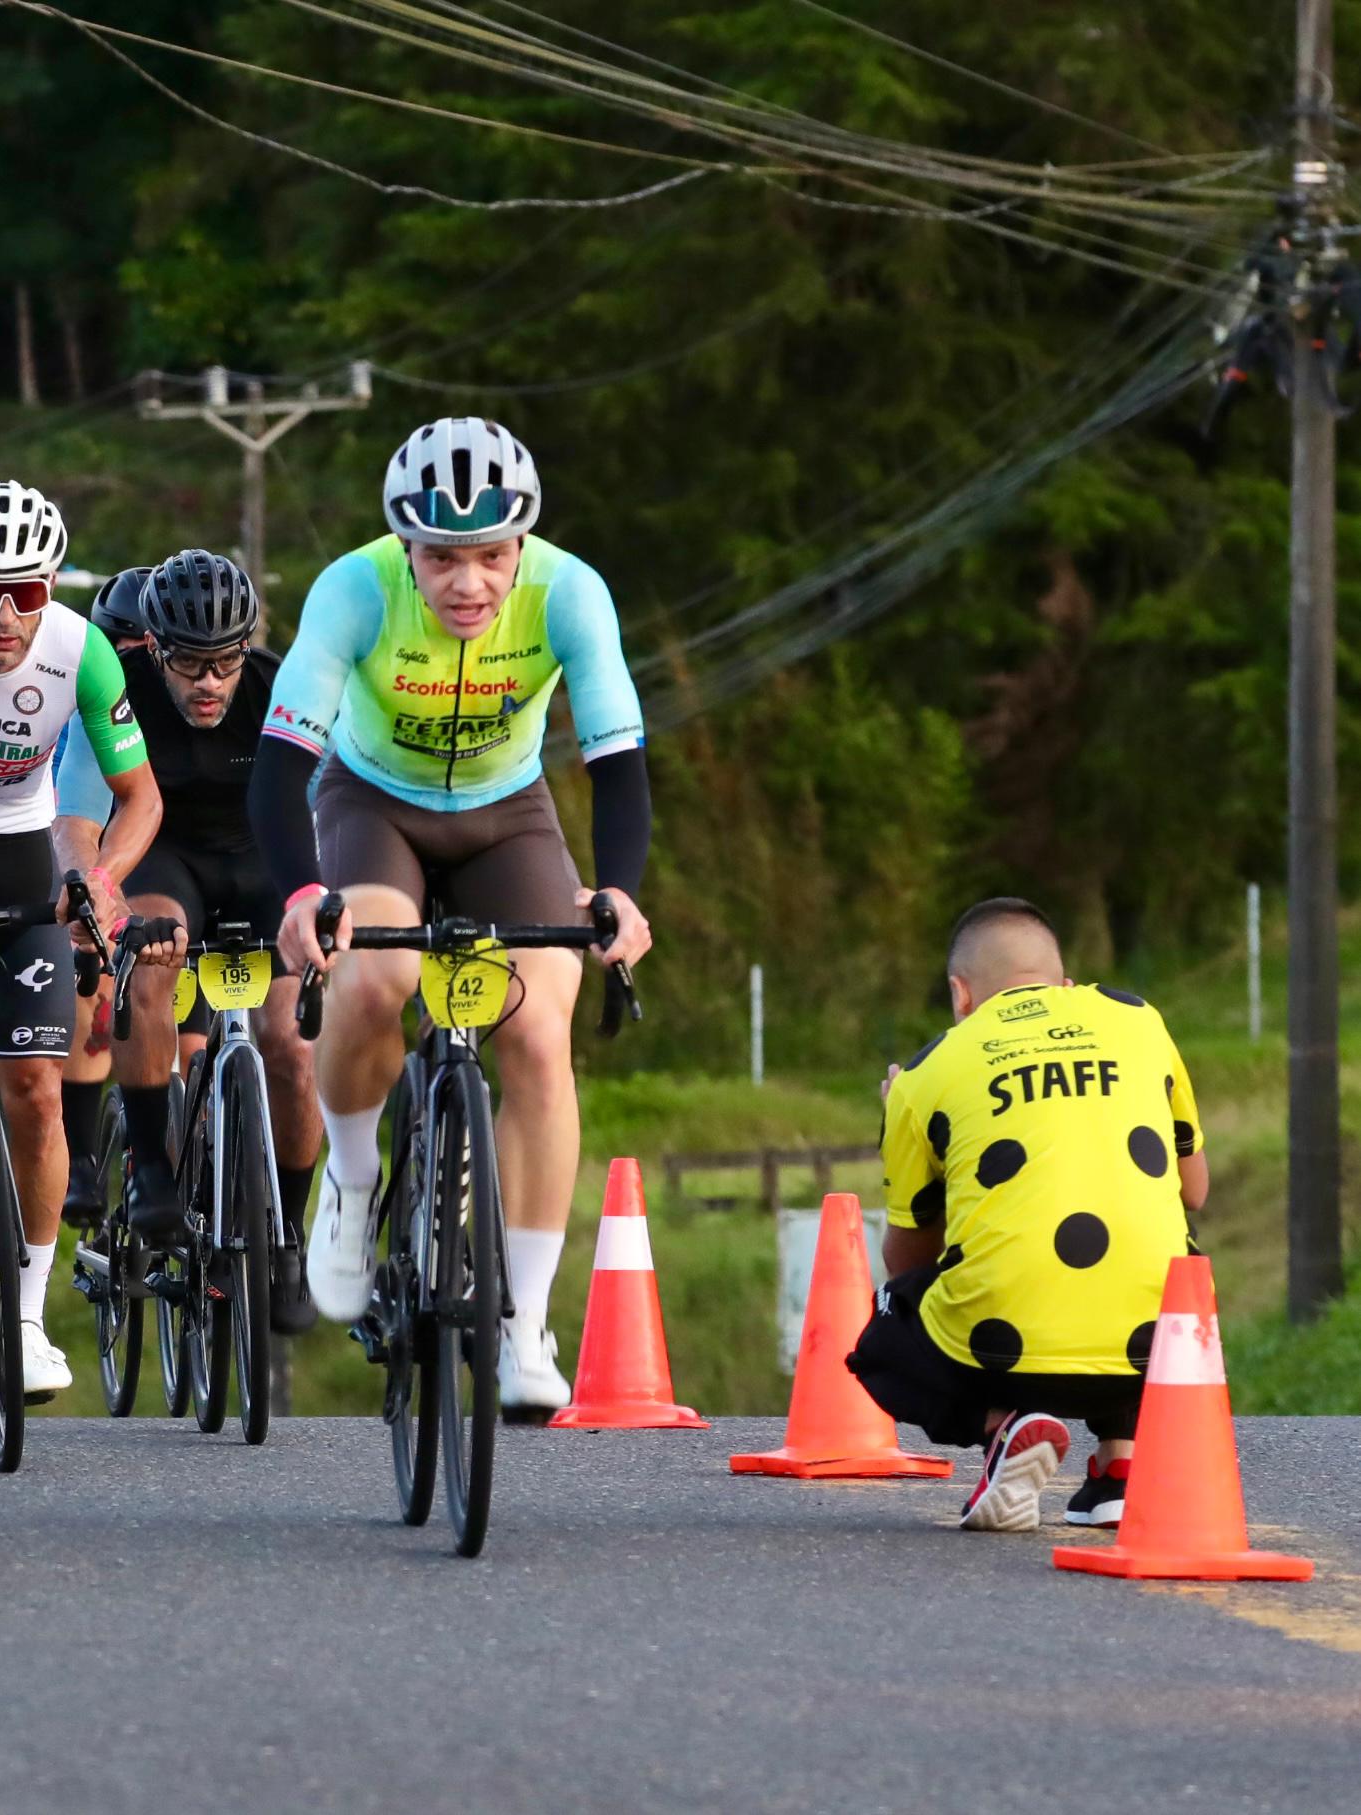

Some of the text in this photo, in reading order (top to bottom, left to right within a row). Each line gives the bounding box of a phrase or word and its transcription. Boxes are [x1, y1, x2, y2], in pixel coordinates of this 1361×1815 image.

[35, 663, 66, 679] TRAMA
[393, 675, 518, 696] Scotiabank
[469, 726, 511, 745] RICA
[220, 968, 251, 985] 195
[988, 1060, 1120, 1117] STAFF
